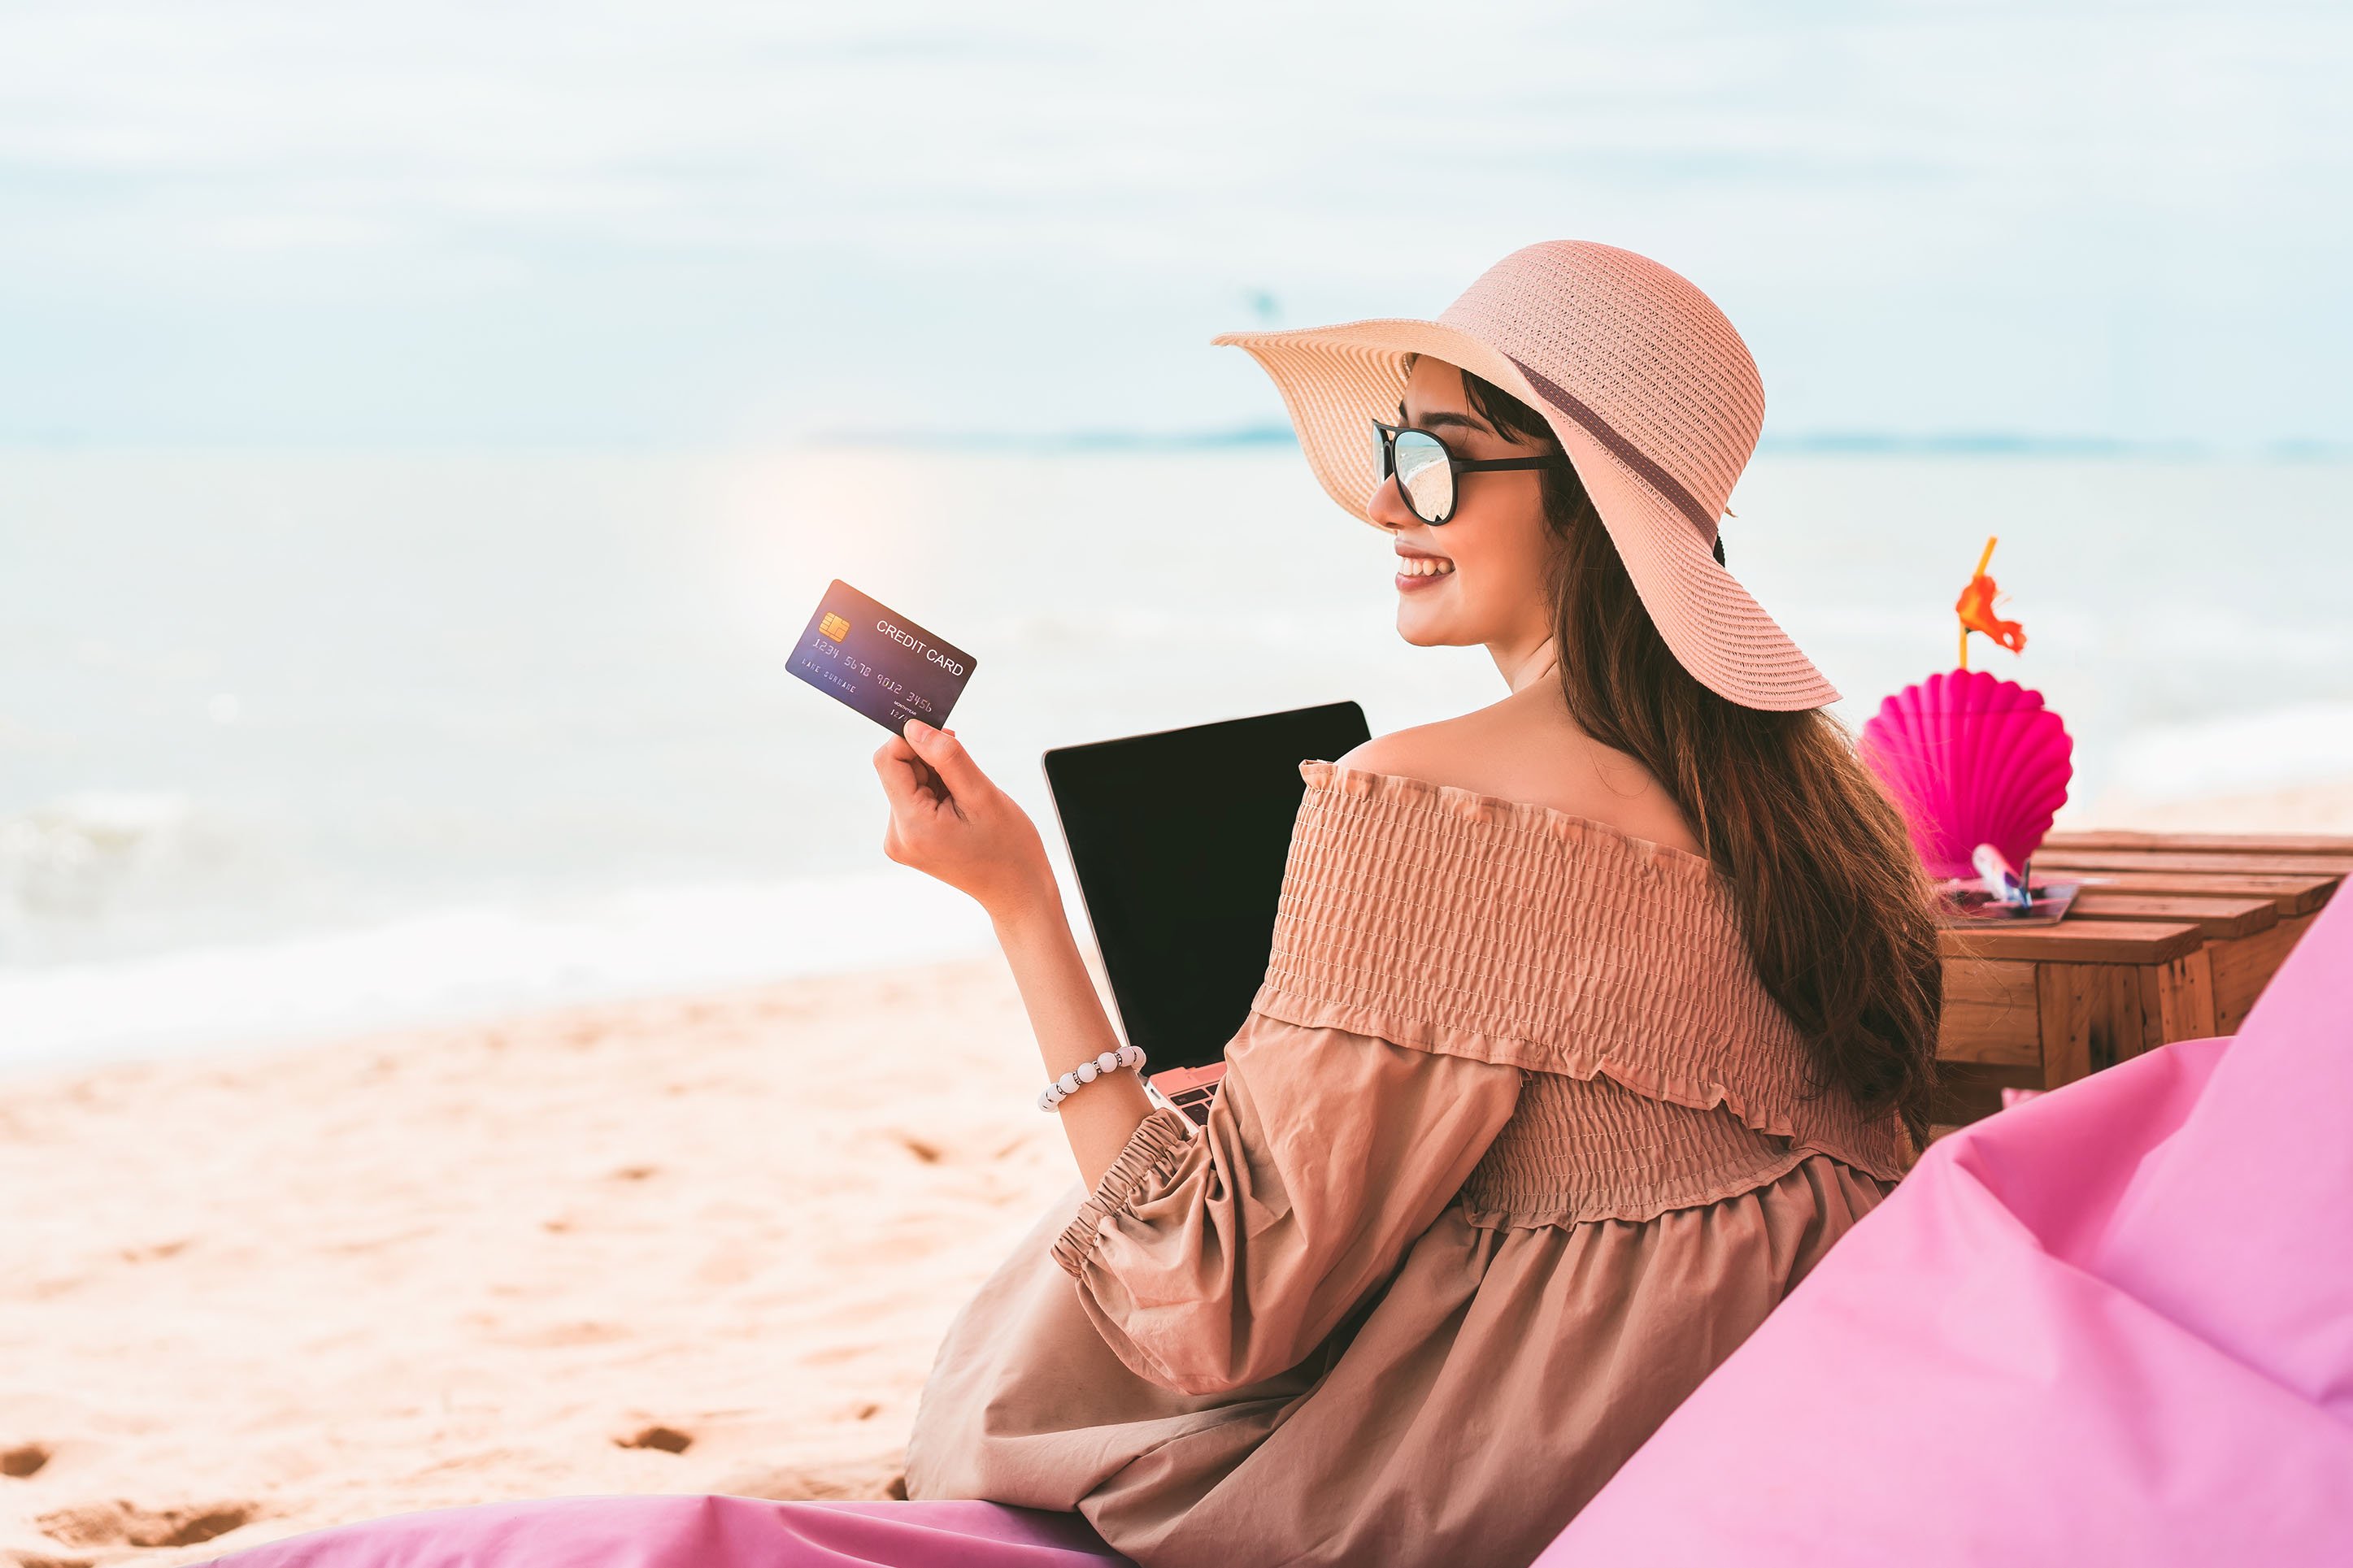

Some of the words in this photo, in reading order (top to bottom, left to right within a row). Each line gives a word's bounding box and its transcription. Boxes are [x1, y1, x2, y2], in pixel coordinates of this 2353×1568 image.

[802, 658, 821, 673] NAME
[824, 671, 856, 693] SURNAME
[813, 638, 840, 658] 1234
[844, 656, 872, 677] 5678
[877, 674, 902, 694] 9012
[906, 692, 932, 712] 3456
[876, 620, 926, 654] CREDIT
[926, 649, 963, 676] CARD
